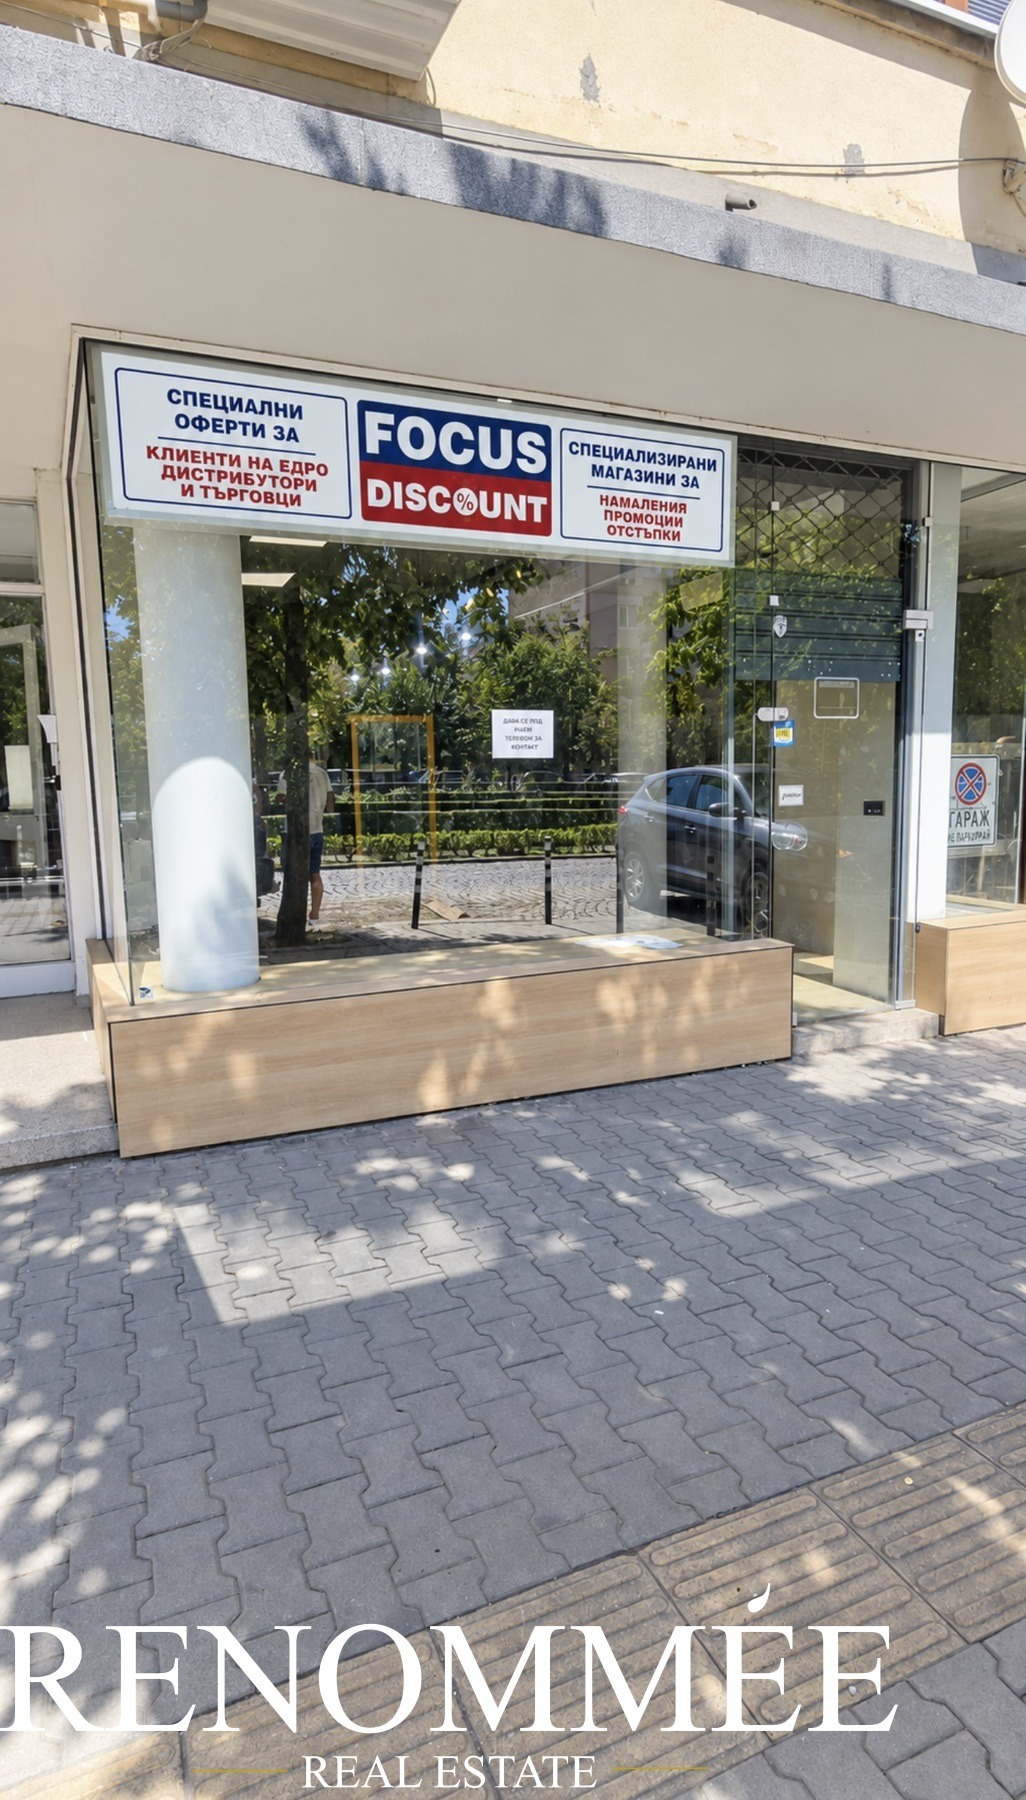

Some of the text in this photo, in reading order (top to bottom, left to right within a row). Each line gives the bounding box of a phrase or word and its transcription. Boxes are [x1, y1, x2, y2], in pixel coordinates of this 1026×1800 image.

[167, 388, 303, 420] СПЕЦИАЛНИ
[174, 413, 300, 443] ОФЕРТИ ЗА
[365, 411, 548, 474] FOCUS
[146, 445, 329, 477] КЛИЕНТИ НА ЕДРО
[568, 440, 717, 473] СПЕЦИАЛИЗИРАНИ
[160, 464, 317, 492] ДИСТРИБУТОРИ
[591, 463, 700, 489] МАГАЗИНИ ЗА
[180, 483, 302, 508] И ТЪРГОВЦИ
[599, 494, 688, 514] НАМАЛЕНИЯ
[603, 509, 684, 528] ПРОМОЦИИ
[606, 524, 682, 542] ОТСТЪПКИ
[949, 810, 990, 828] ГАРАЖ
